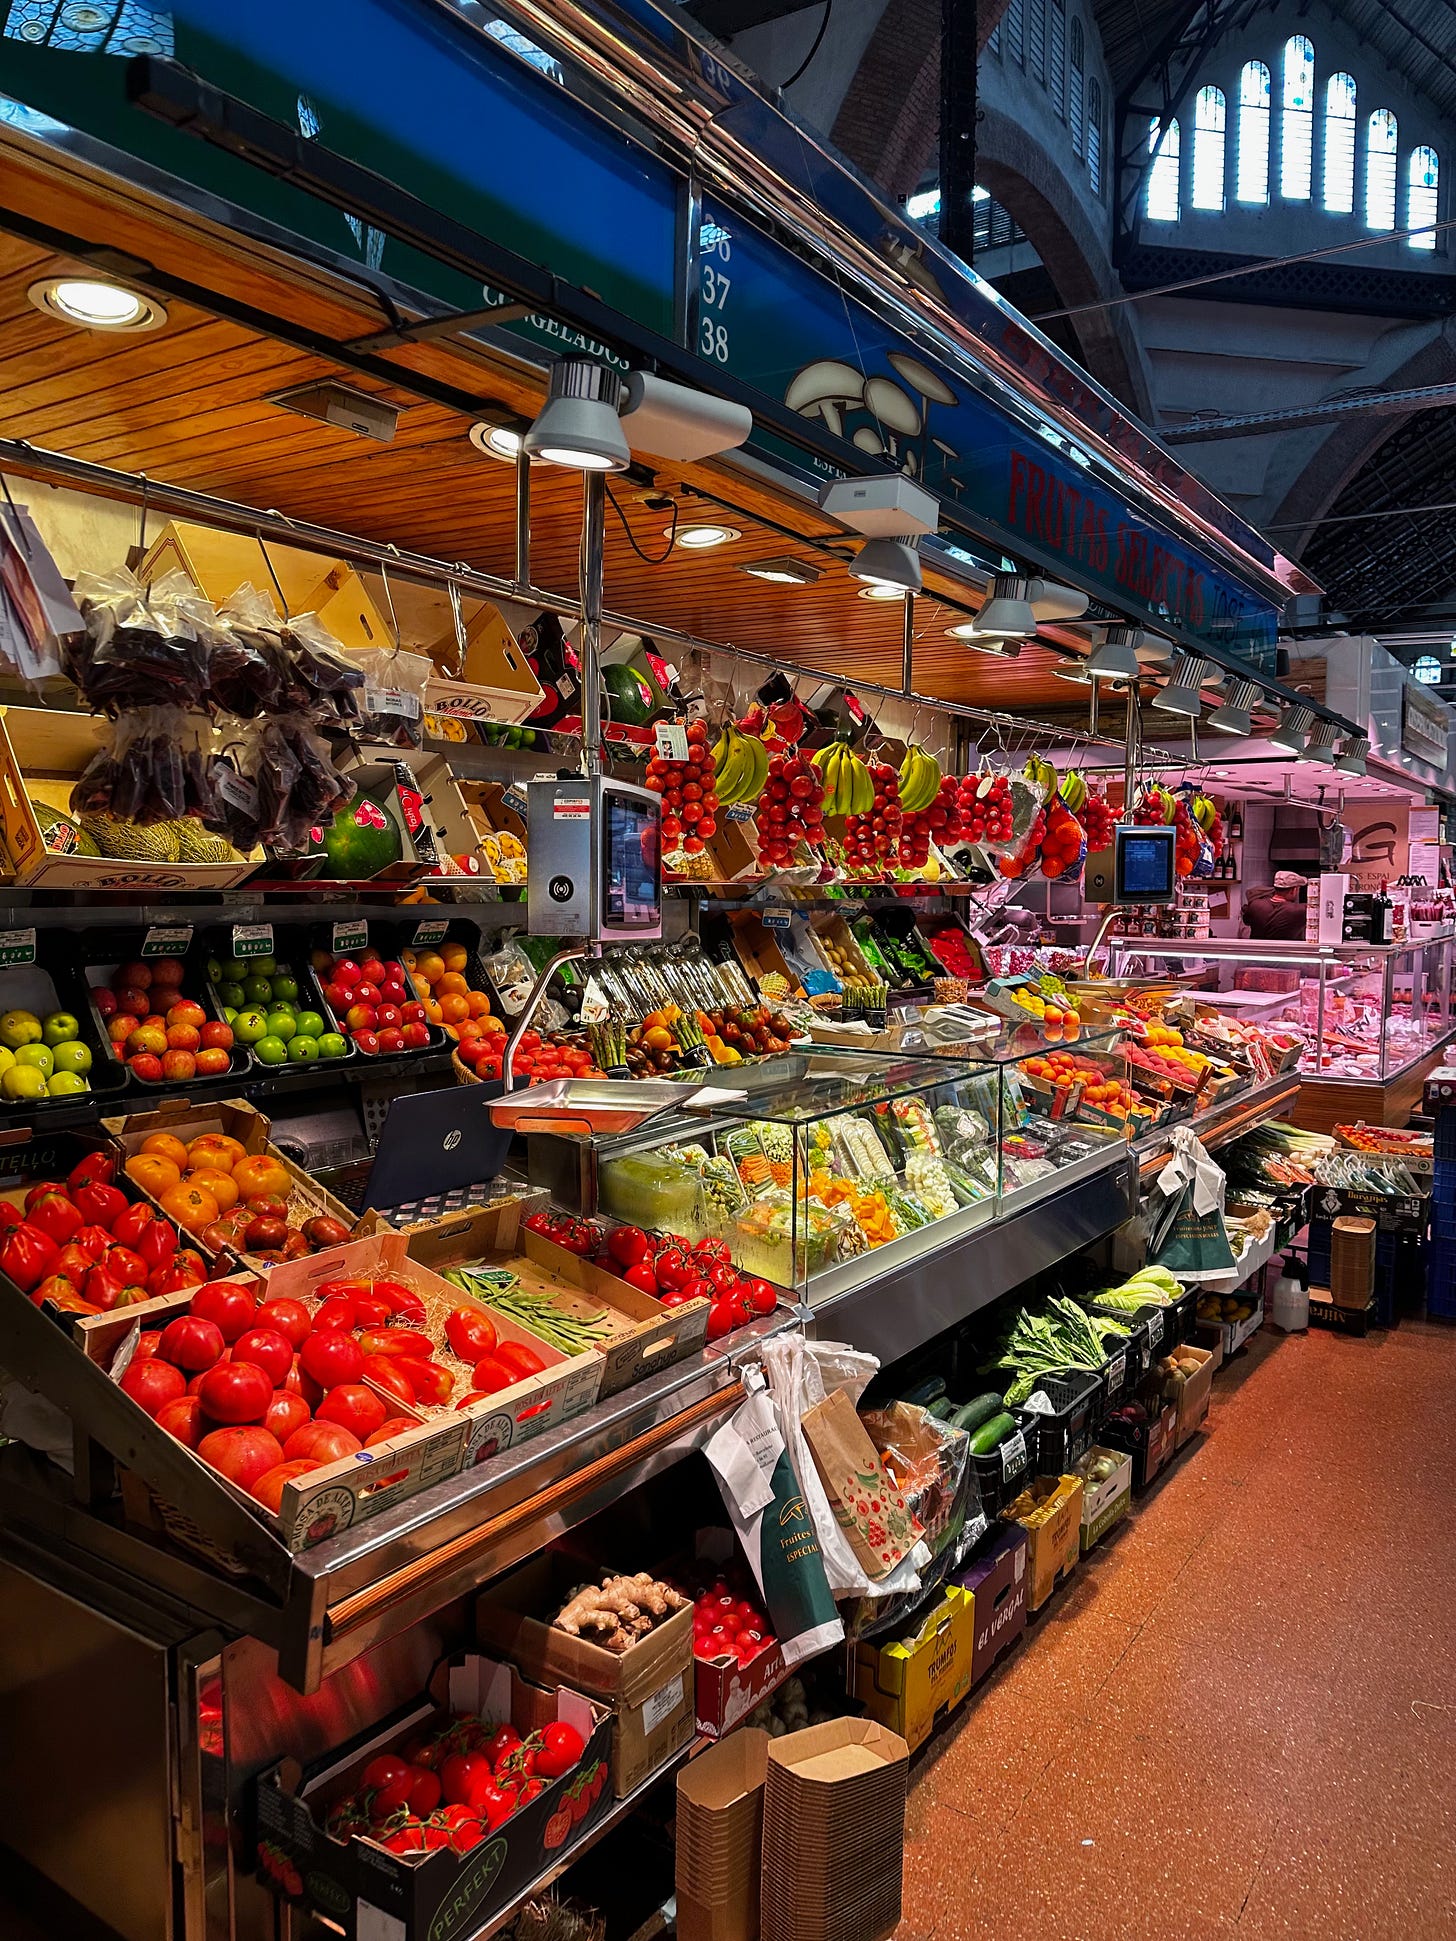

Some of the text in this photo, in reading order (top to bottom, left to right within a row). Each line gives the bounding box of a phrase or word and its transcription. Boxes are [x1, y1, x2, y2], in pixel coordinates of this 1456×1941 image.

[702, 264, 732, 311] 37
[701, 316, 730, 363] 38
[1007, 447, 1110, 574] FRUTAS
[1112, 520, 1207, 628] SELECTAS
[435, 695, 488, 717] BOLLO
[99, 872, 182, 887] BOLLO
[443, 1129, 462, 1151] hp
[484, 1420, 496, 1433] DE
[292, 1506, 315, 1540] ROSA
[315, 1492, 333, 1509] DE
[334, 1491, 353, 1519] ALTEA
[780, 1531, 812, 1549] Fruites
[927, 1639, 958, 1679] TRUMFOS
[434, 1844, 502, 1940] PERFEKT
